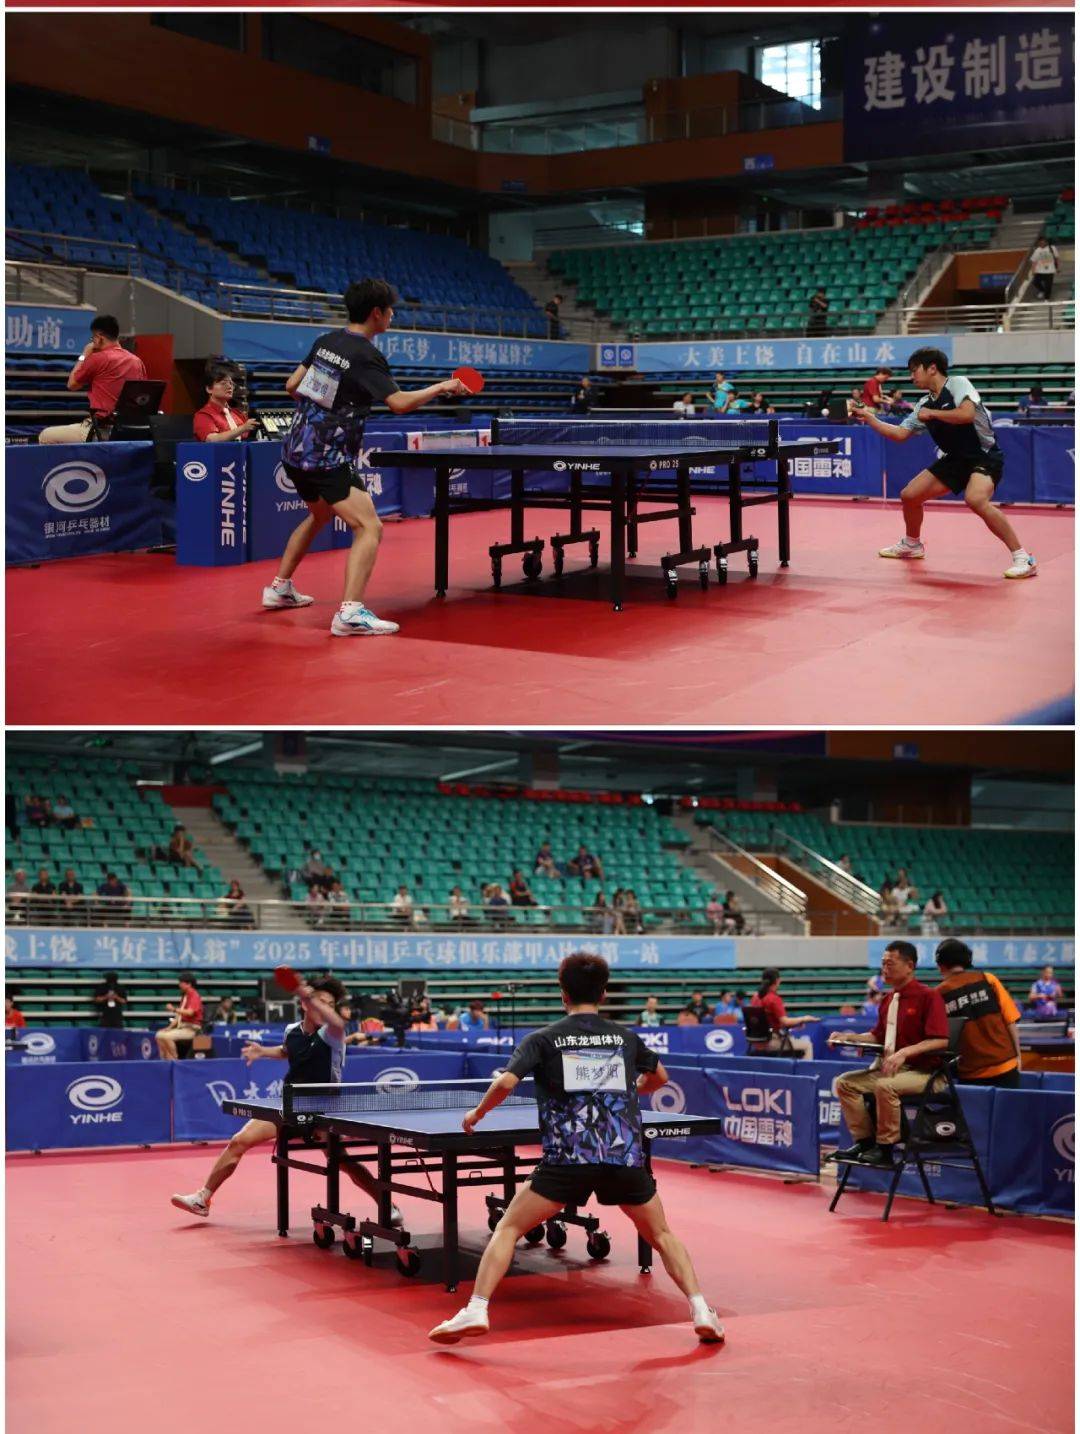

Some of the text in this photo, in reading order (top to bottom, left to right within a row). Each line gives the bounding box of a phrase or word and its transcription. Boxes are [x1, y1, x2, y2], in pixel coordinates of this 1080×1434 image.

[864, 28, 1062, 112] 建设制造
[684, 342, 895, 368] 大美上饶 自在山水
[659, 460, 671, 469] PRO
[221, 460, 235, 547] YINHE
[44, 516, 110, 535] 银河乒乓器材
[253, 940, 311, 962] 2025
[722, 1087, 792, 1116] LOKI
[70, 1112, 123, 1125] YINHE
[659, 1128, 691, 1136] YINHE
